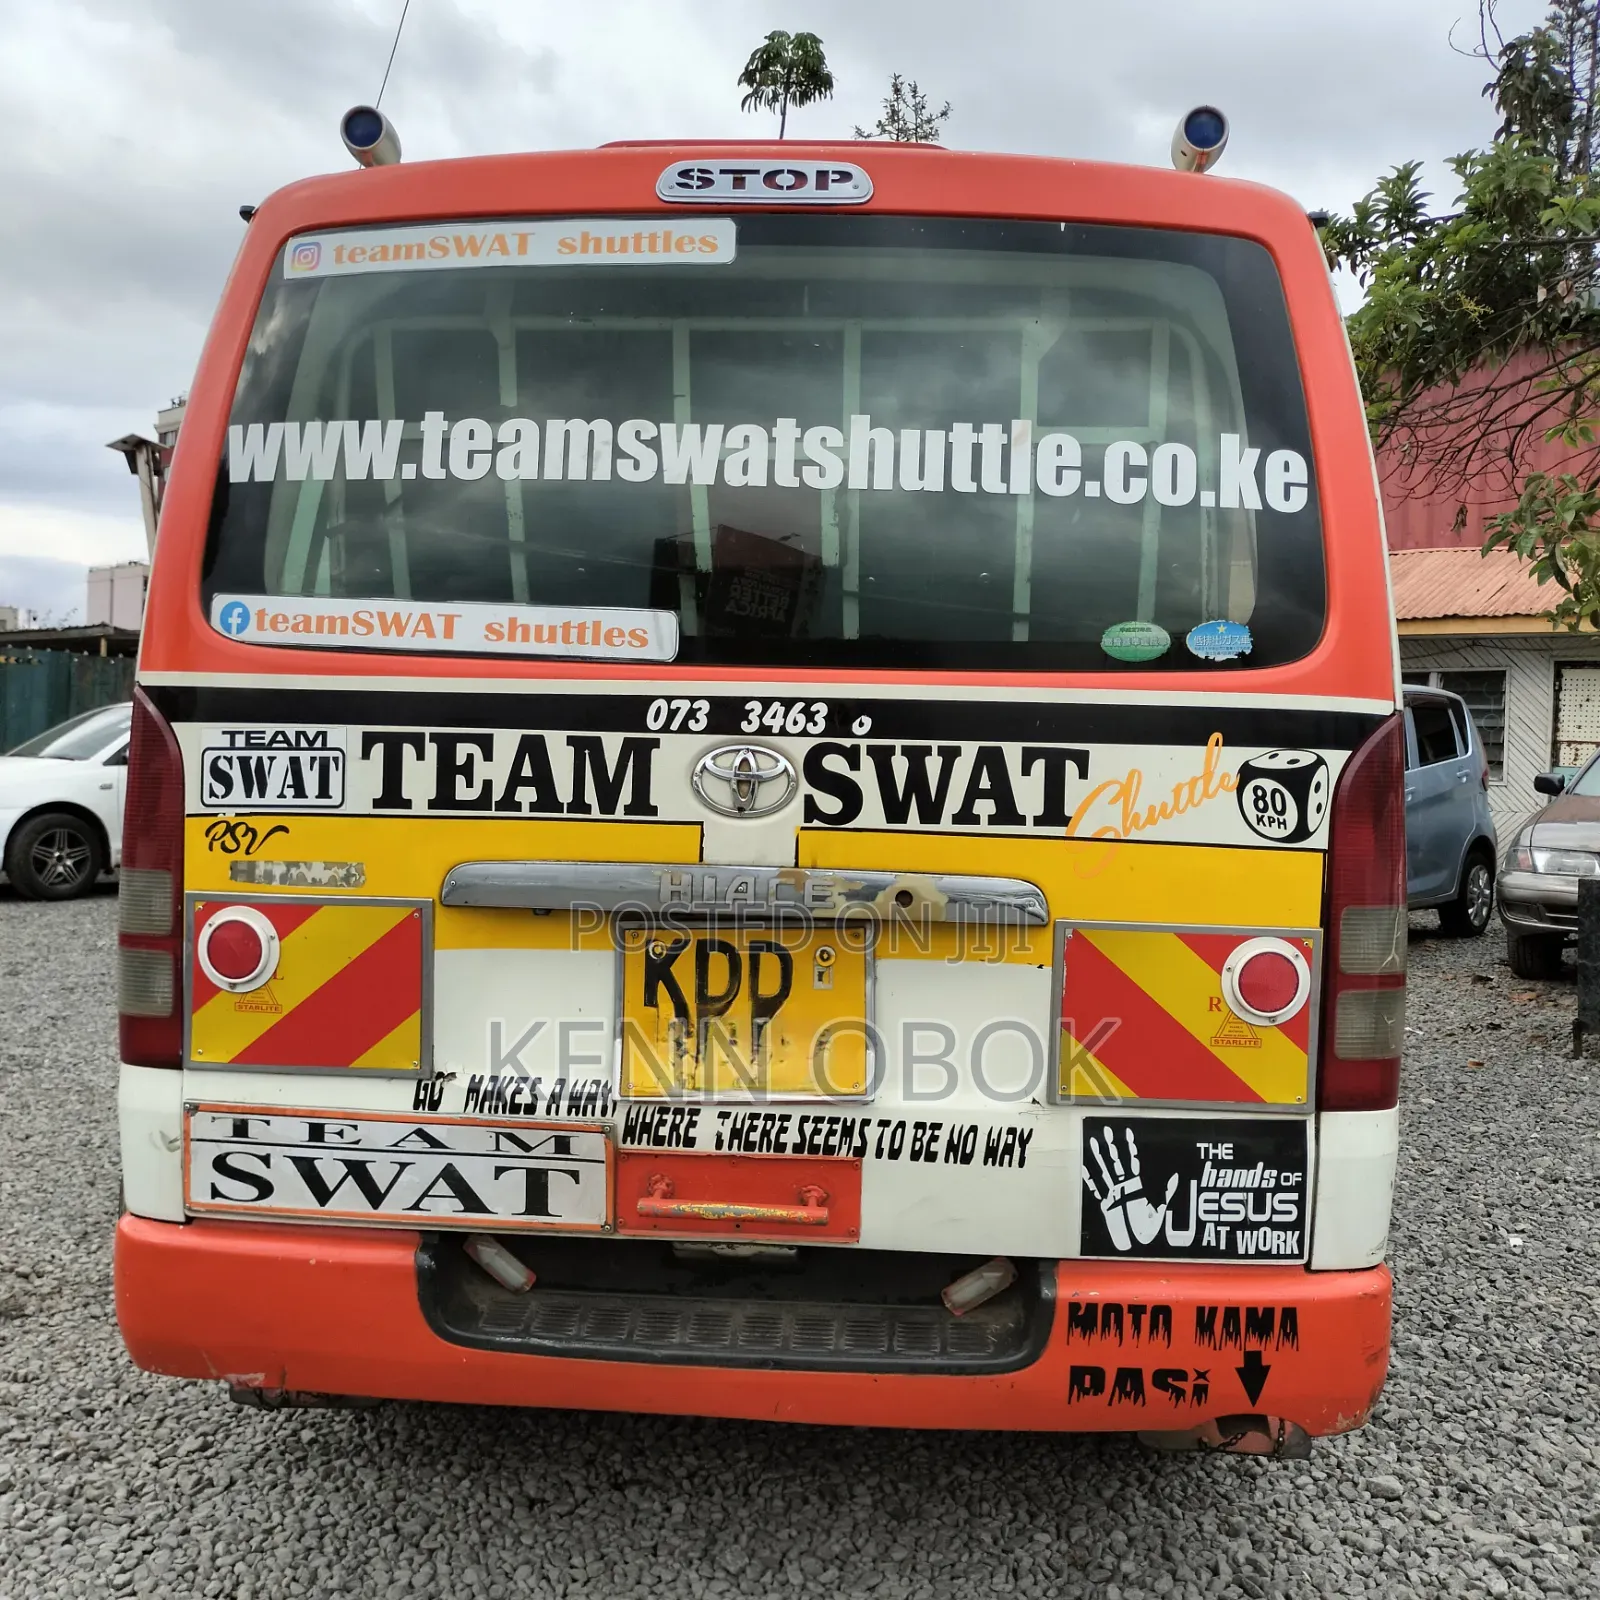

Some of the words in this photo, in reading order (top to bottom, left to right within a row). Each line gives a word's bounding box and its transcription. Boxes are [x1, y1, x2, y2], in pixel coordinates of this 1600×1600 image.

[675, 167, 854, 191] STOP
[333, 231, 536, 265] teamSWAT
[557, 229, 719, 256] shuttles
[228, 411, 1309, 514] www.teamswatshuttle.co.ke
[254, 607, 462, 641] teamSWAT
[483, 618, 649, 649] shuttles
[646, 698, 711, 731] 073
[740, 700, 829, 735] 3463
[221, 730, 328, 749] TEAM
[208, 754, 340, 800] SWAT
[361, 731, 661, 817] TEAM
[803, 742, 1090, 827] SWAT
[1064, 731, 1241, 879] Shuttle
[1252, 784, 1287, 816] 80
[204, 820, 290, 856] PSV
[1256, 813, 1287, 831] KPH
[659, 872, 836, 908] HIACE
[237, 1004, 281, 1012] STARLITE
[1207, 995, 1222, 1012] R
[1213, 1038, 1260, 1046] STARLITE
[210, 1116, 582, 1156] TEAM
[464, 1074, 542, 1115] MAKES
[545, 1078, 567, 1116] A
[566, 1079, 617, 1118] WAY
[622, 1106, 701, 1149] WHERE
[714, 1111, 793, 1154] THERE
[792, 1116, 872, 1158] SEEMS
[874, 1119, 907, 1160] TO
[909, 1121, 944, 1163] BE
[943, 1123, 976, 1165] NO
[982, 1126, 1034, 1169] WAY
[1196, 1142, 1234, 1160] THE
[210, 1150, 580, 1218] SWAT
[1200, 1161, 1278, 1189] hands
[1280, 1172, 1303, 1186] OF
[1165, 1179, 1300, 1247] JESUS
[1202, 1222, 1231, 1250] AT
[1236, 1226, 1300, 1256] WORK
[1066, 1301, 1173, 1349] MOTO
[1194, 1305, 1300, 1352] KAMA
